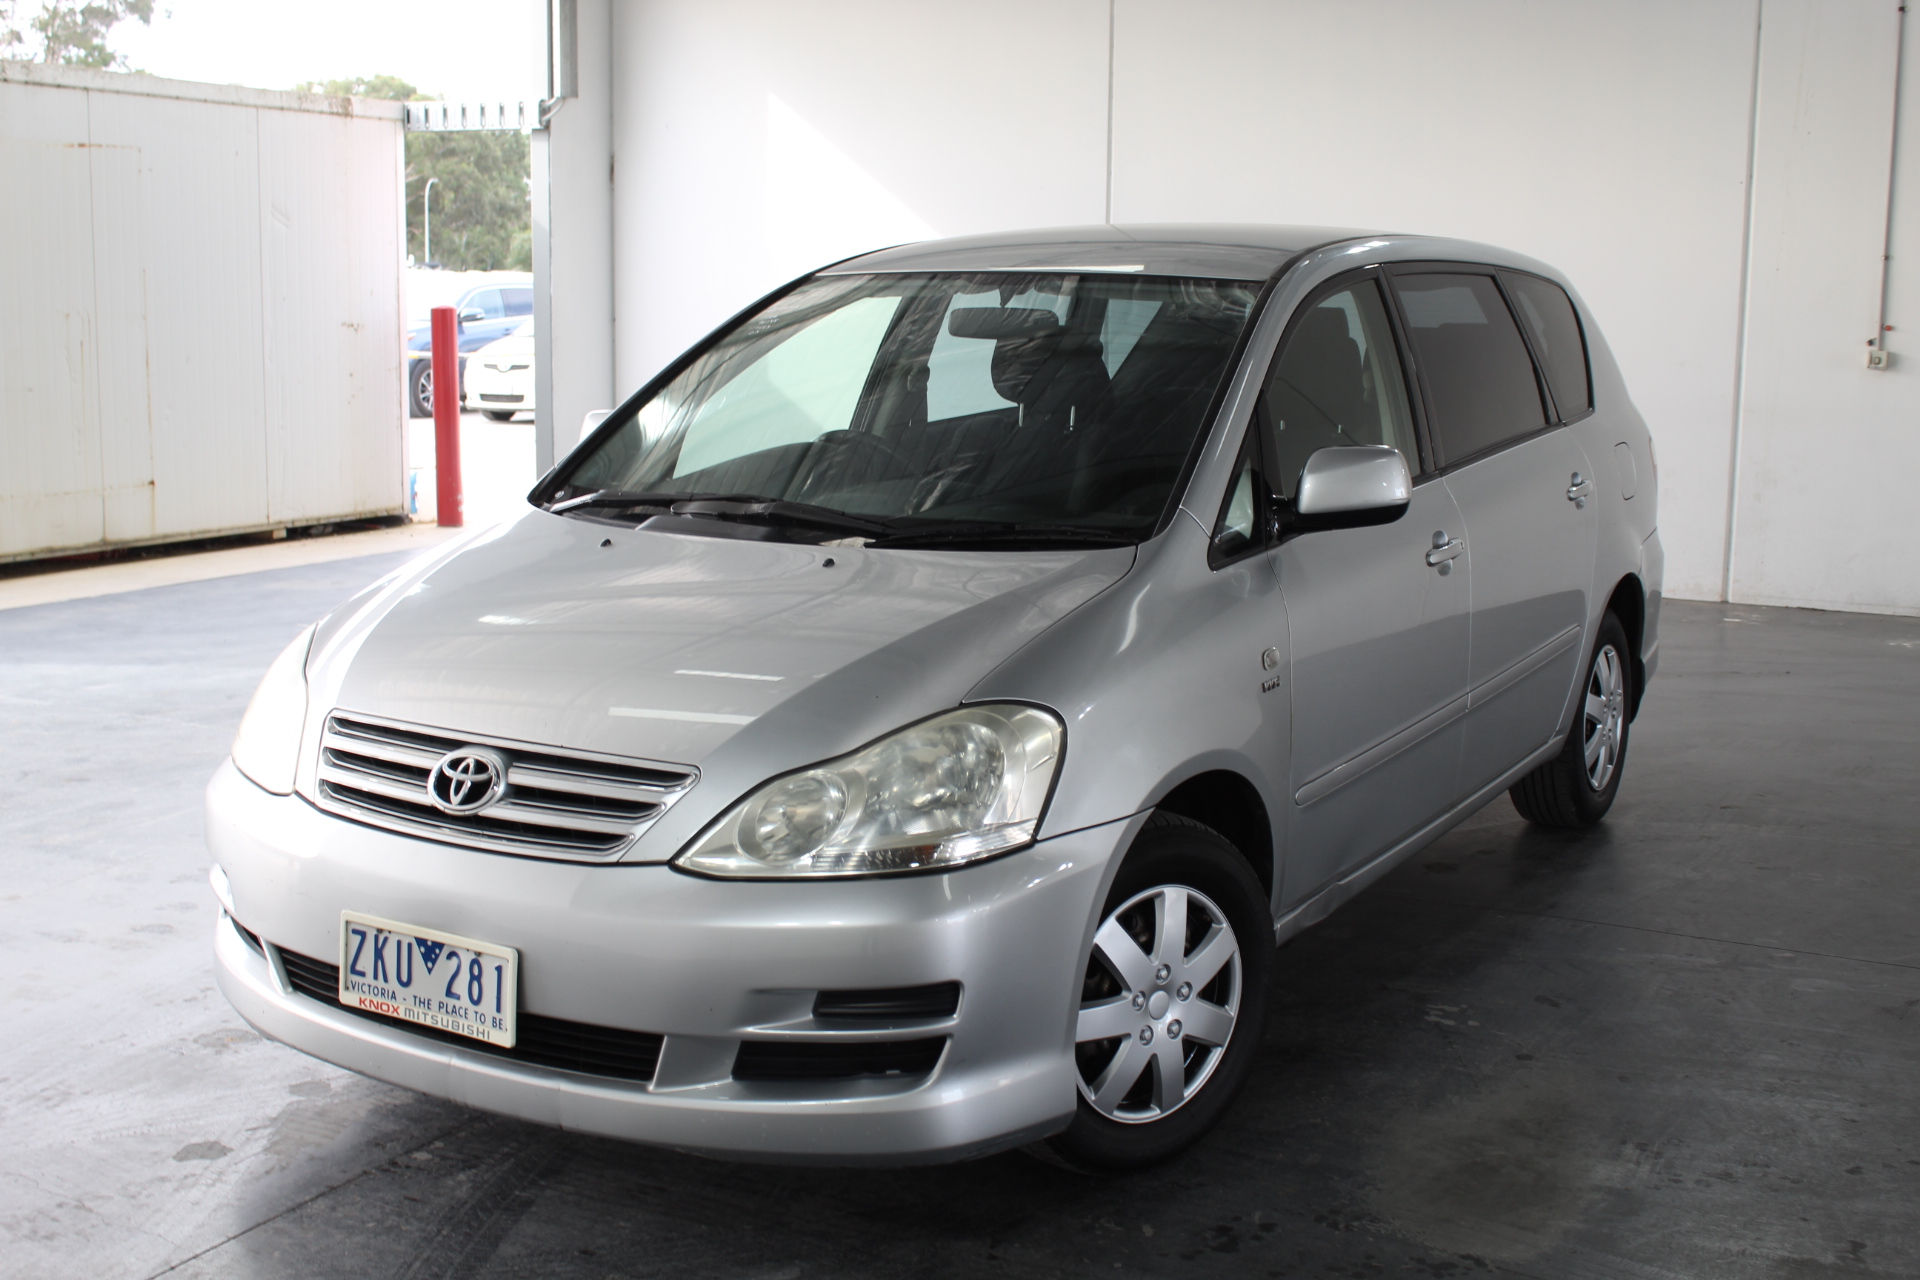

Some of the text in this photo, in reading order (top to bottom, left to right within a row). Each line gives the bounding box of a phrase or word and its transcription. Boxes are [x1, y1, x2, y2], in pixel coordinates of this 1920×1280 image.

[350, 928, 503, 1014] ZKU 281
[350, 980, 397, 1001] VICTORIA
[413, 995, 432, 1010] THE
[438, 1001, 469, 1019] PLACE
[474, 1011, 486, 1024] TO
[359, 996, 490, 1040] KNOX MITSUBISHI
